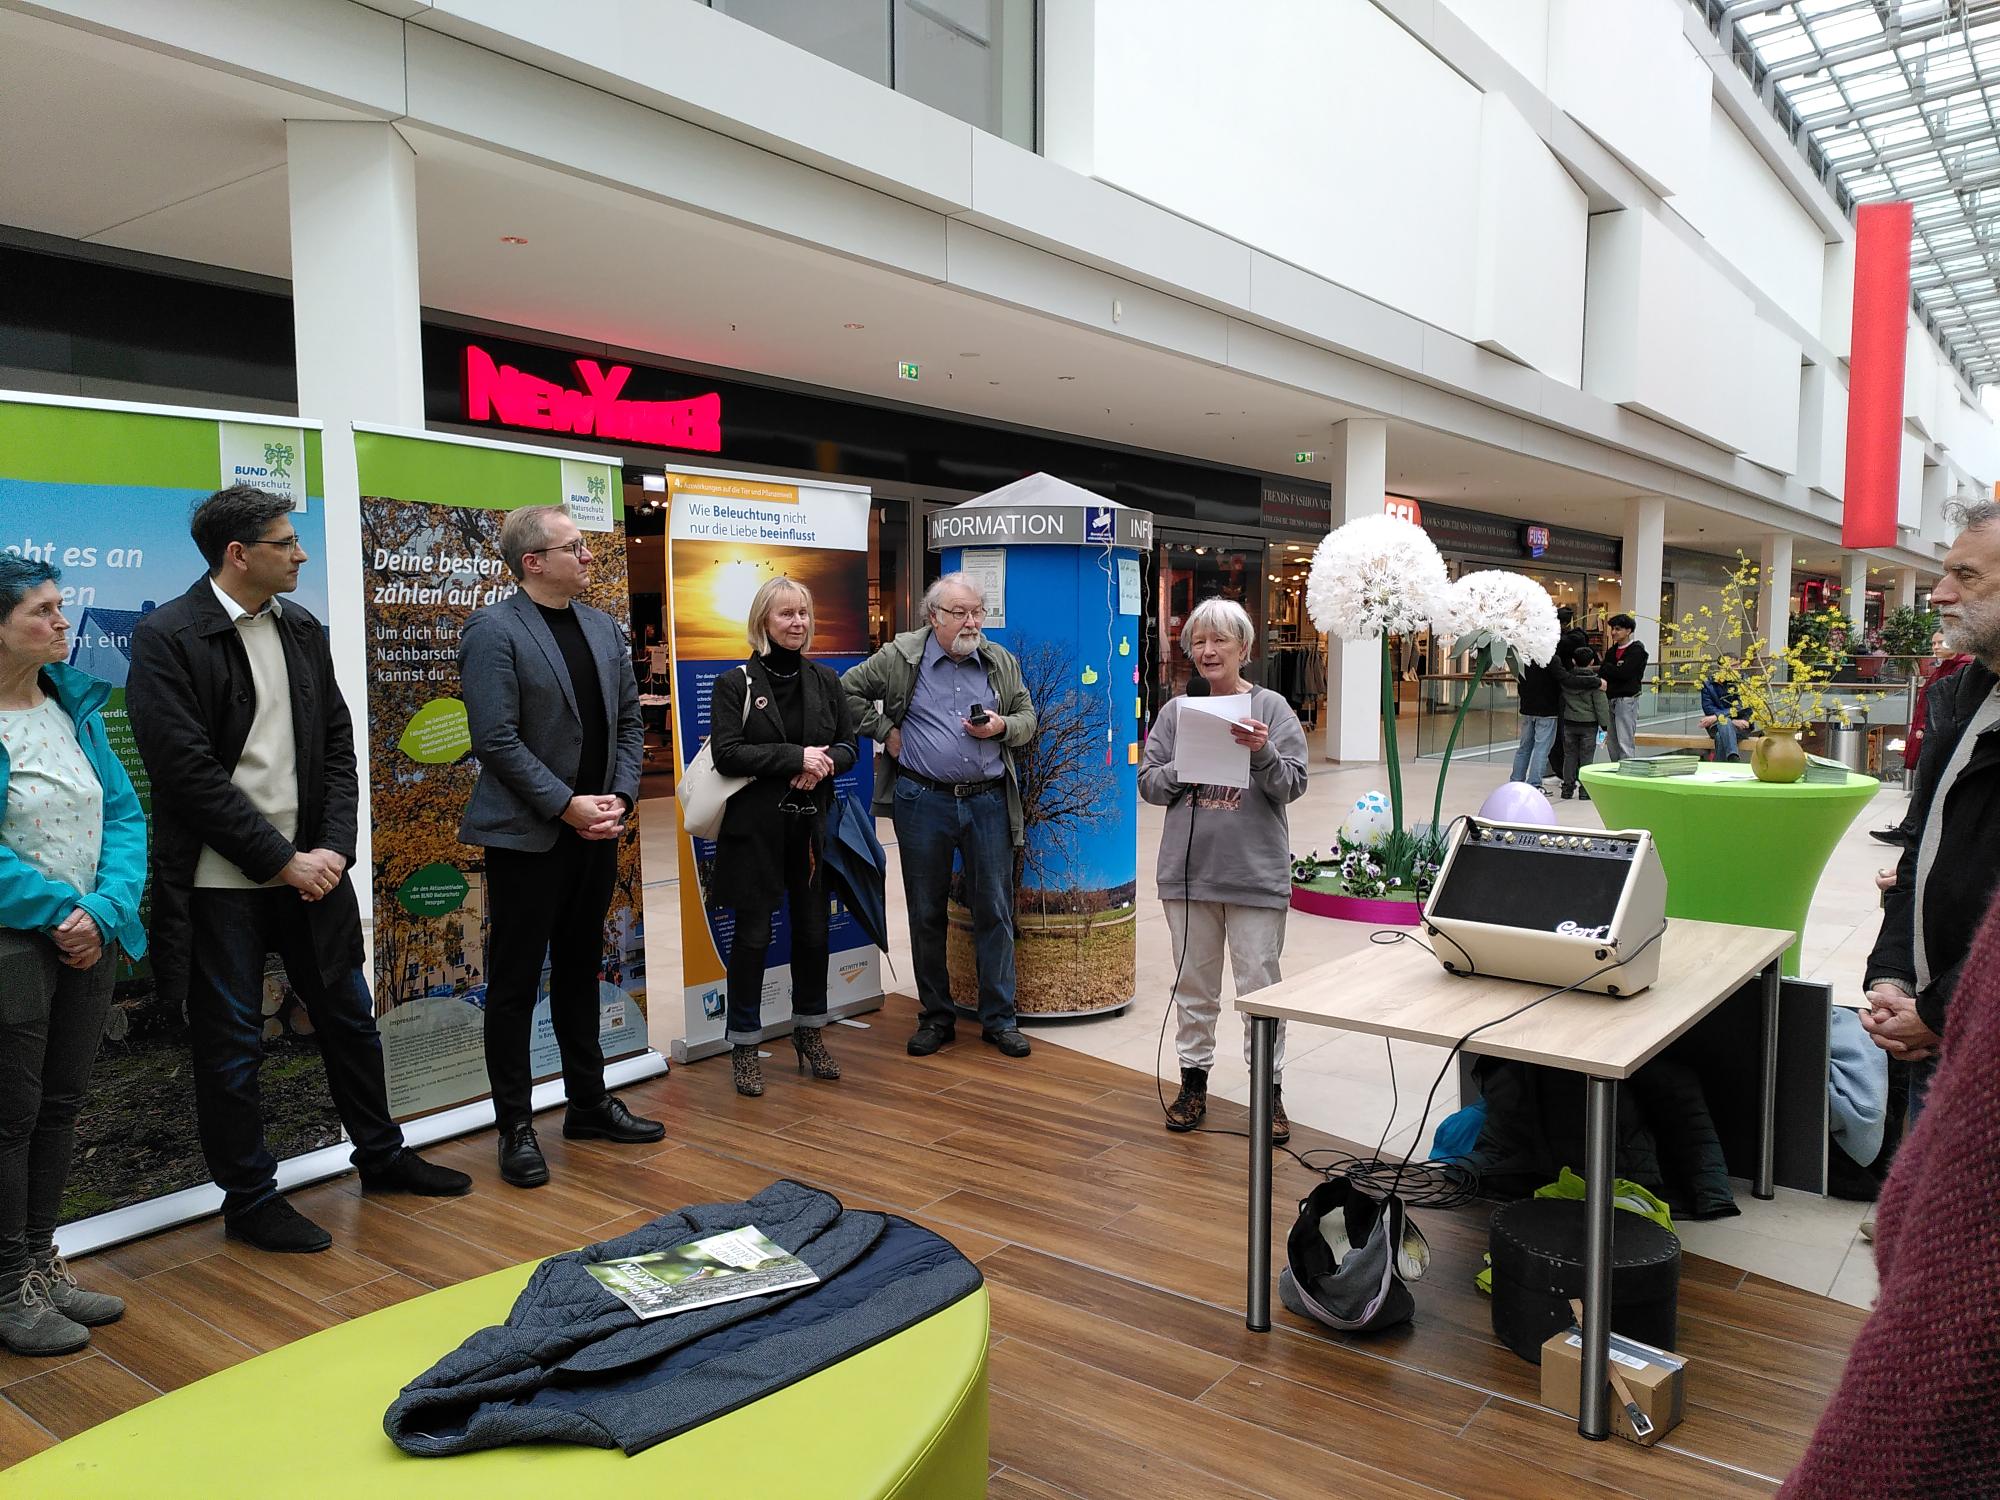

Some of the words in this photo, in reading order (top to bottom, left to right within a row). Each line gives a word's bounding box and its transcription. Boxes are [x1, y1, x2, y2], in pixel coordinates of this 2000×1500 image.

[235, 465, 268, 476] BUND
[235, 478, 292, 490] Naturschutz
[571, 494, 590, 503] BUND
[1264, 489, 1290, 504] TRENDS
[1290, 493, 1319, 508] FASHION
[571, 504, 604, 514] Naturschutz
[578, 513, 596, 522] Bayern
[689, 503, 711, 517] Wie
[713, 506, 780, 525] Beleuchtung
[783, 511, 807, 525] nicht
[1385, 501, 1414, 525] SSL
[690, 523, 709, 534] nur
[711, 522, 728, 536] die
[730, 525, 758, 538] Liebe
[760, 526, 816, 541] beeinflusst
[932, 514, 1064, 539] INFORMATION
[1529, 529, 1548, 545] FUSSL
[63, 547, 97, 568] es
[107, 548, 143, 568] an
[374, 548, 434, 572] Deine
[439, 552, 503, 575] besten
[60, 586, 95, 606] en
[373, 582, 443, 604] zählen
[447, 584, 481, 609] auf
[376, 626, 398, 640] Um
[402, 625, 431, 640] dich
[435, 625, 453, 640] für
[378, 668, 424, 682] kannst
[428, 667, 444, 681] du
[98, 709, 128, 718] verdic
[1556, 920, 1606, 939] Cort
